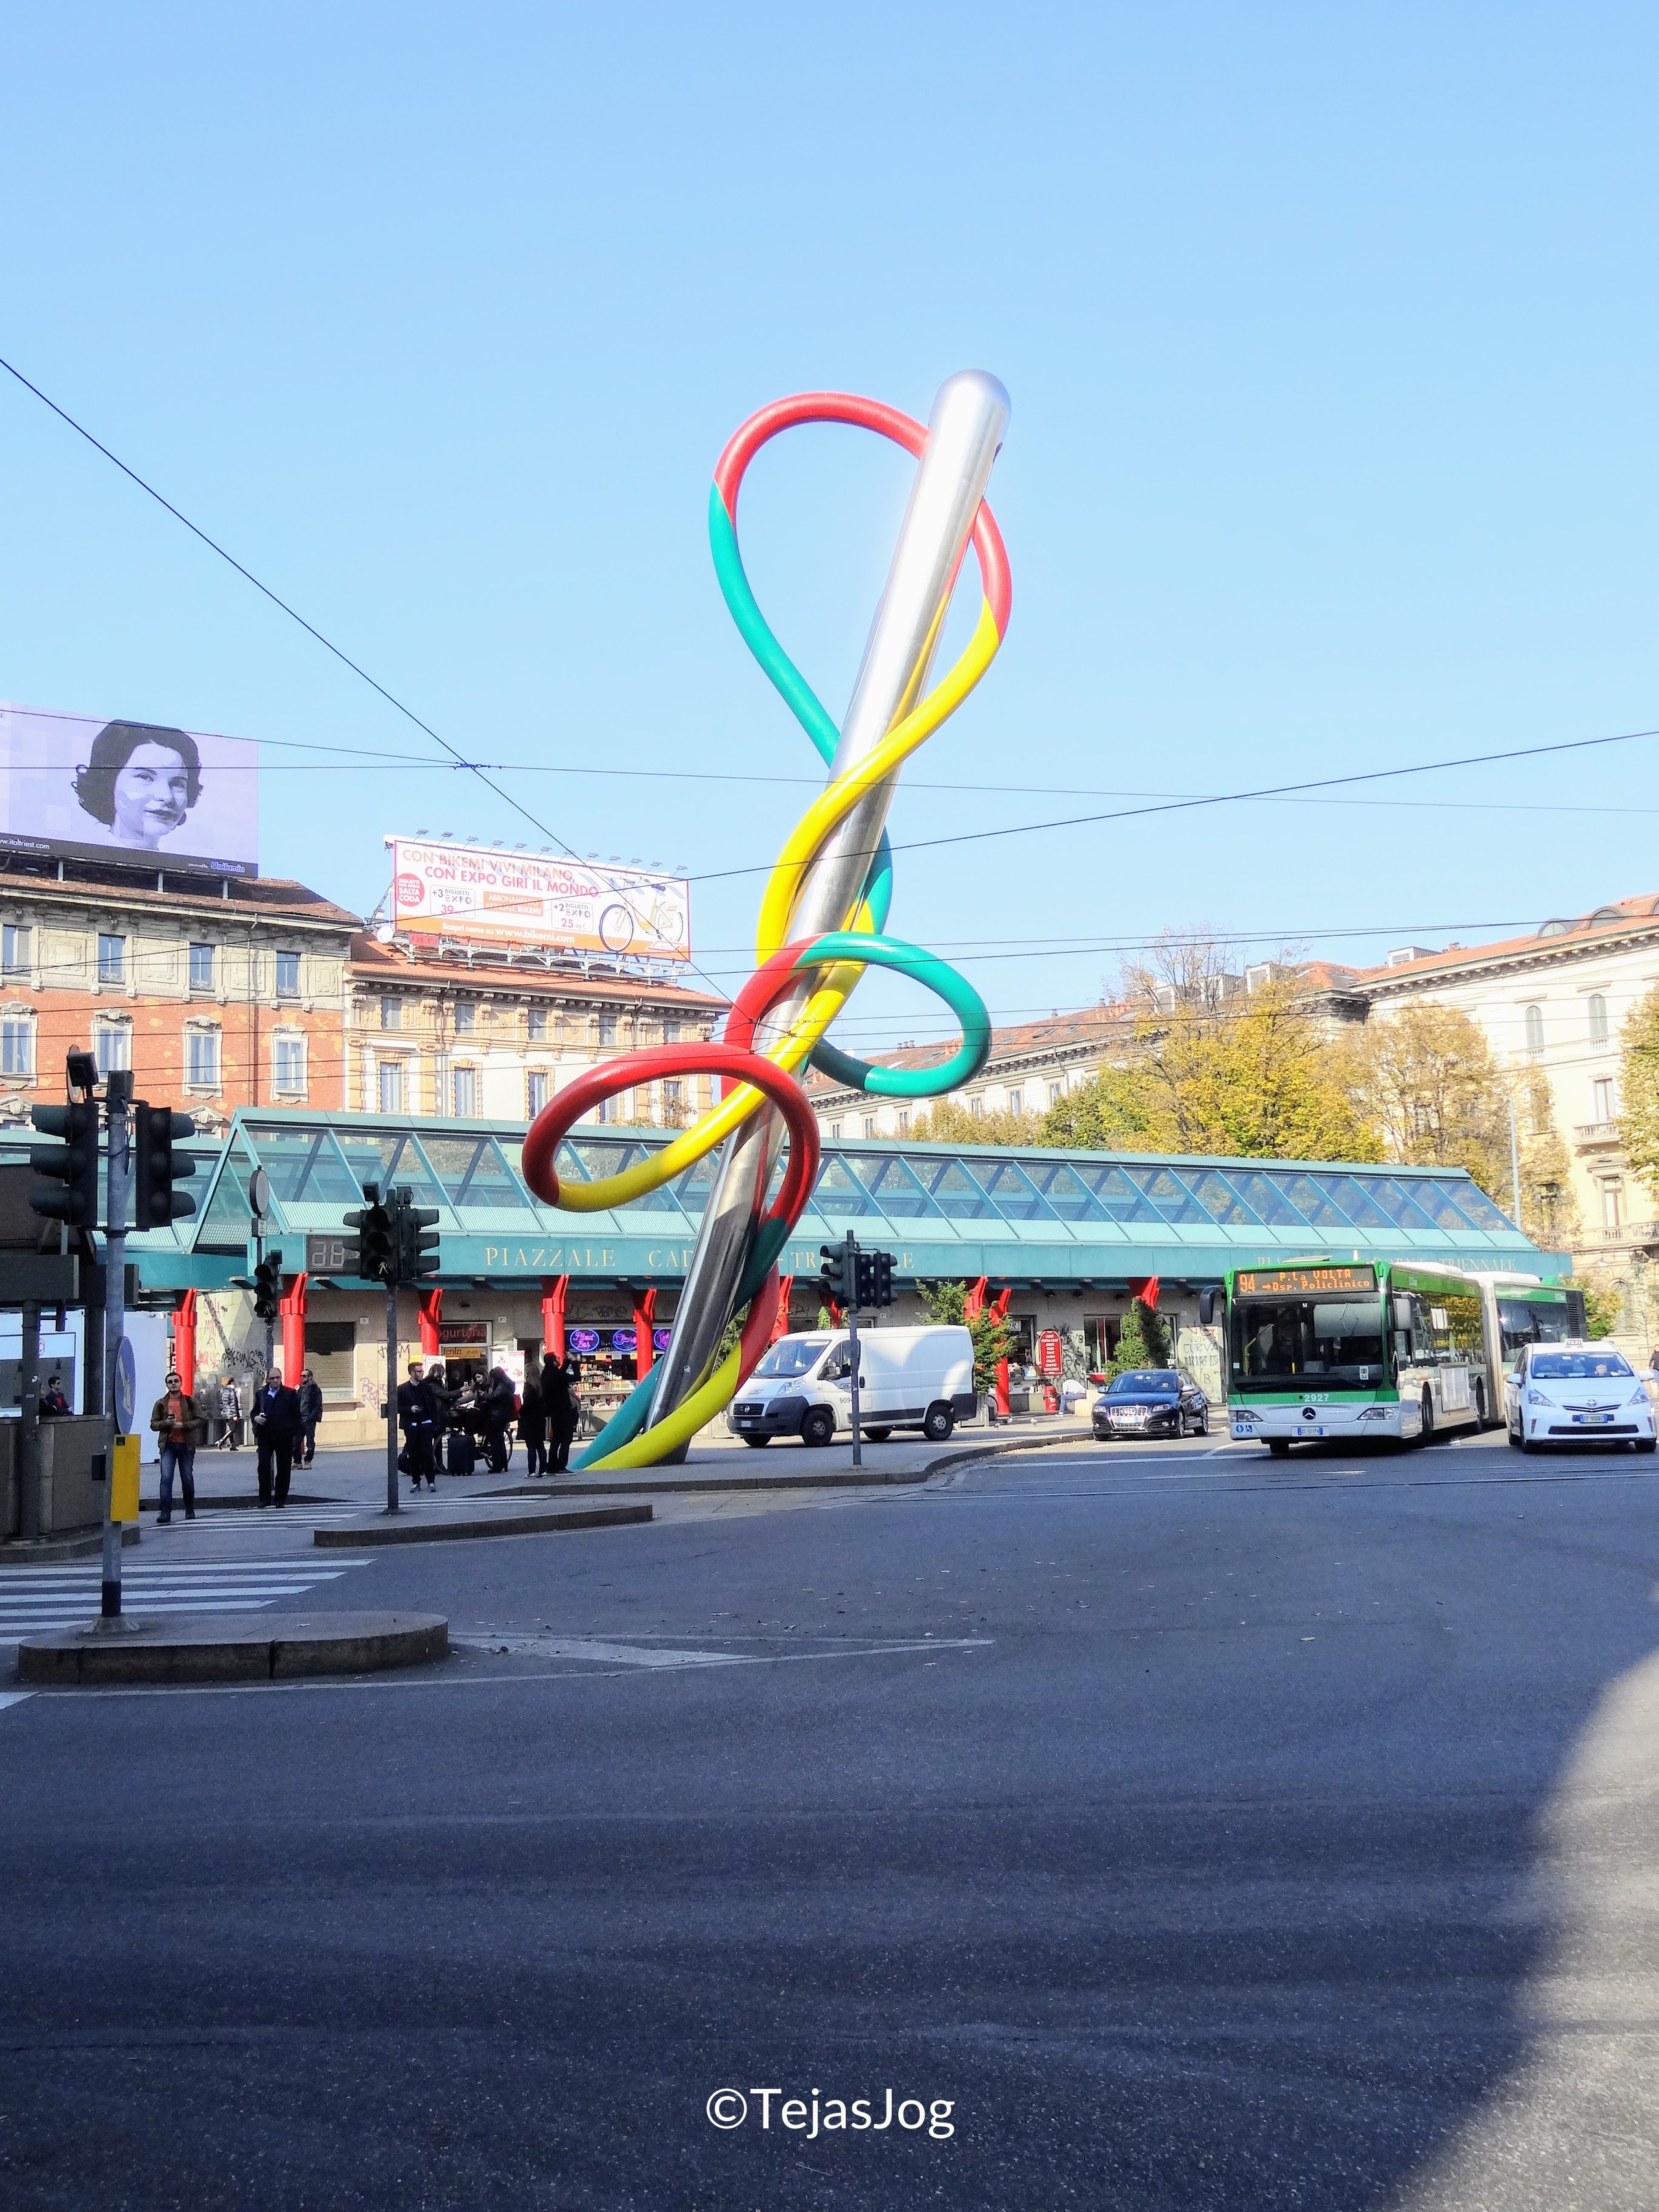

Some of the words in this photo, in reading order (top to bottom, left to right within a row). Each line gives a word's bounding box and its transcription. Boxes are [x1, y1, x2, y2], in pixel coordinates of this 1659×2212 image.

[402, 849, 434, 863] CON
[439, 854, 485, 870] BIKEMI
[489, 860, 516, 874] VIVI
[520, 864, 575, 883] MILANO,
[424, 866, 456, 880] CON
[461, 870, 497, 885] EXPO
[502, 875, 528, 889] GIRI
[533, 879, 542, 891] IL
[547, 881, 601, 898] MONDO.
[398, 887, 421, 896] SALTA
[432, 889, 443, 898] +3
[398, 894, 421, 903] CODA
[445, 894, 472, 905] EXPO
[489, 894, 539, 906] ABBONAMENTO
[518, 905, 542, 914] BIKEMI
[566, 909, 591, 918] EXPO
[442, 922, 465, 933] Scopri
[466, 926, 485, 934] come
[495, 928, 575, 944] www.bikemi.com
[485, 1247, 616, 1268] PIAZZALE
[1279, 1271, 1306, 1281] P.ta
[1312, 1268, 1352, 1279] VOLTA
[1239, 1274, 1255, 1292] 94
[1302, 1279, 1370, 1289] Policlinico
[1304, 1393, 1329, 1402] 2927
